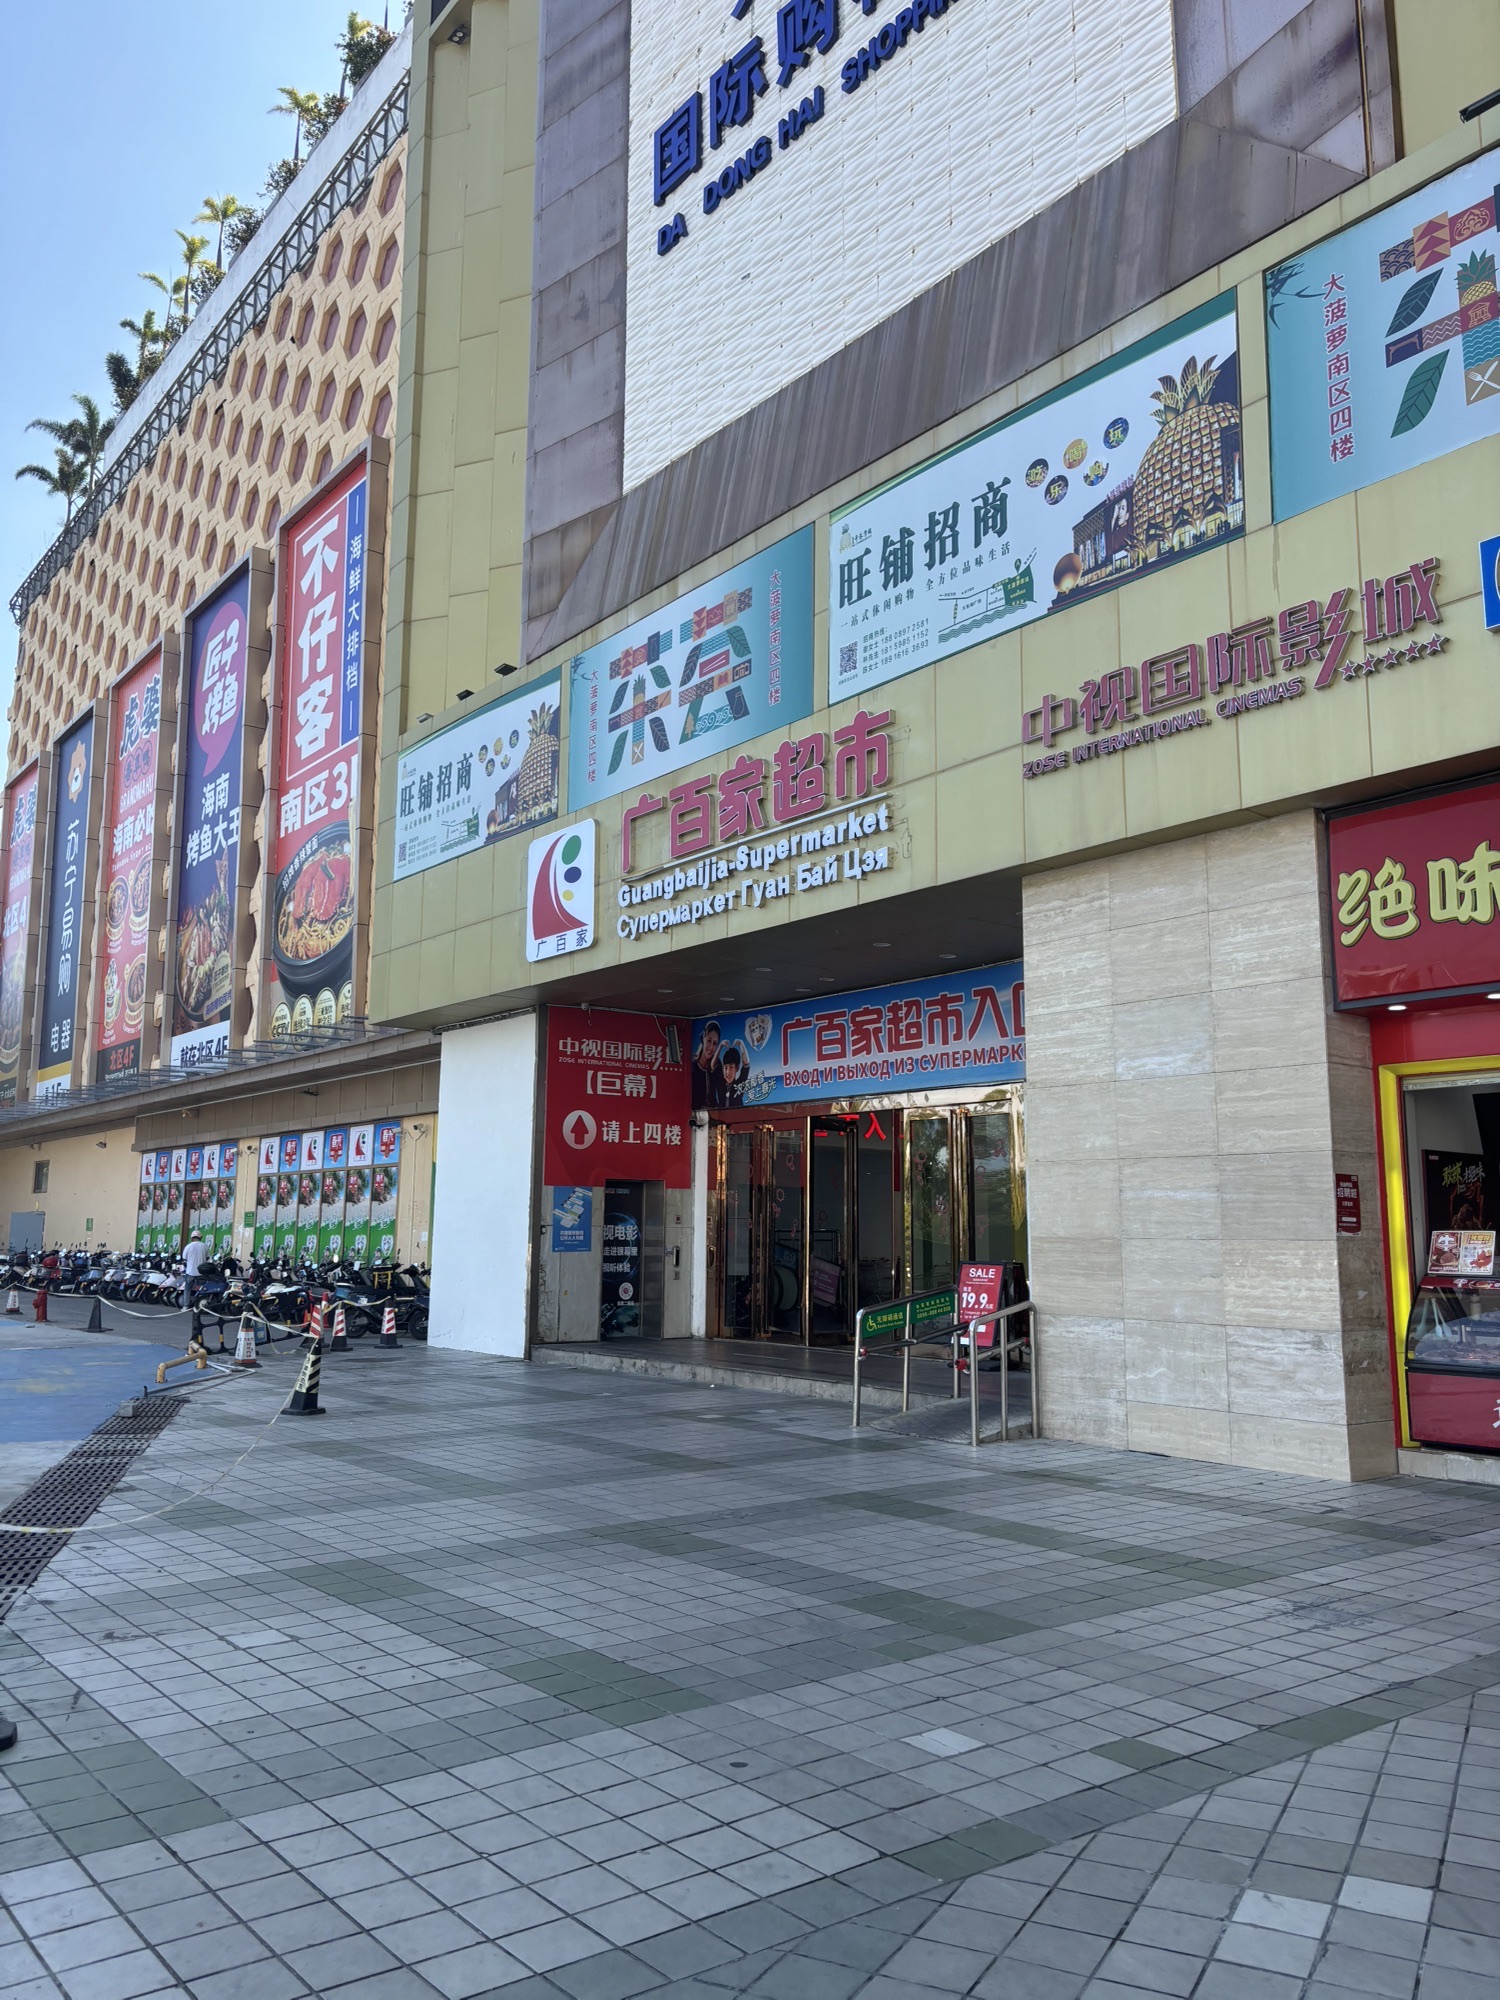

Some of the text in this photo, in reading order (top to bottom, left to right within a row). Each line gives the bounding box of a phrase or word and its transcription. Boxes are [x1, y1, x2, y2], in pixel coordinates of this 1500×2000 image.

[654, 0, 877, 207] 国际购
[658, 0, 959, 256] DA DONG HAI SHOPPI
[1323, 273, 1354, 464] 大菠萝南区四楼
[839, 476, 1011, 609] 旺铺招商
[841, 541, 1010, 628] 一站式休闲购物 全方位品味生活
[294, 513, 340, 760] 不仔客
[345, 534, 362, 692] 海鲜大排档
[769, 569, 782, 707] 大菠萝南区四楼
[1021, 556, 1442, 748] 中视国际影城
[587, 669, 598, 783] 大菠萝南区四楼
[1022, 676, 1306, 779] ZOSE INTERNATIONAL CINEMAS
[186, 806, 240, 869] 烤鱼大王
[201, 772, 230, 820] 海南
[400, 752, 474, 818] 旺铺招商
[621, 709, 895, 874] 广百家超市
[616, 846, 889, 940] Супермаркет Гуан Бай Цзя
[617, 803, 893, 908] Guangbaijia-Supermarket
[1337, 840, 1500, 946] 绝味
[58, 819, 80, 998] 苏宁易购
[536, 928, 588, 957] 广百家
[50, 1018, 71, 1053] 电器
[577, 1058, 623, 1068] INTERNATIONAL
[624, 1062, 650, 1070] CINEMAS
[784, 1042, 1026, 1089] ВХОД И ВЫХОД ИЗ СУПЕРМАРК
[601, 1120, 682, 1146] 请上四楼
[969, 1268, 996, 1278] SALE
